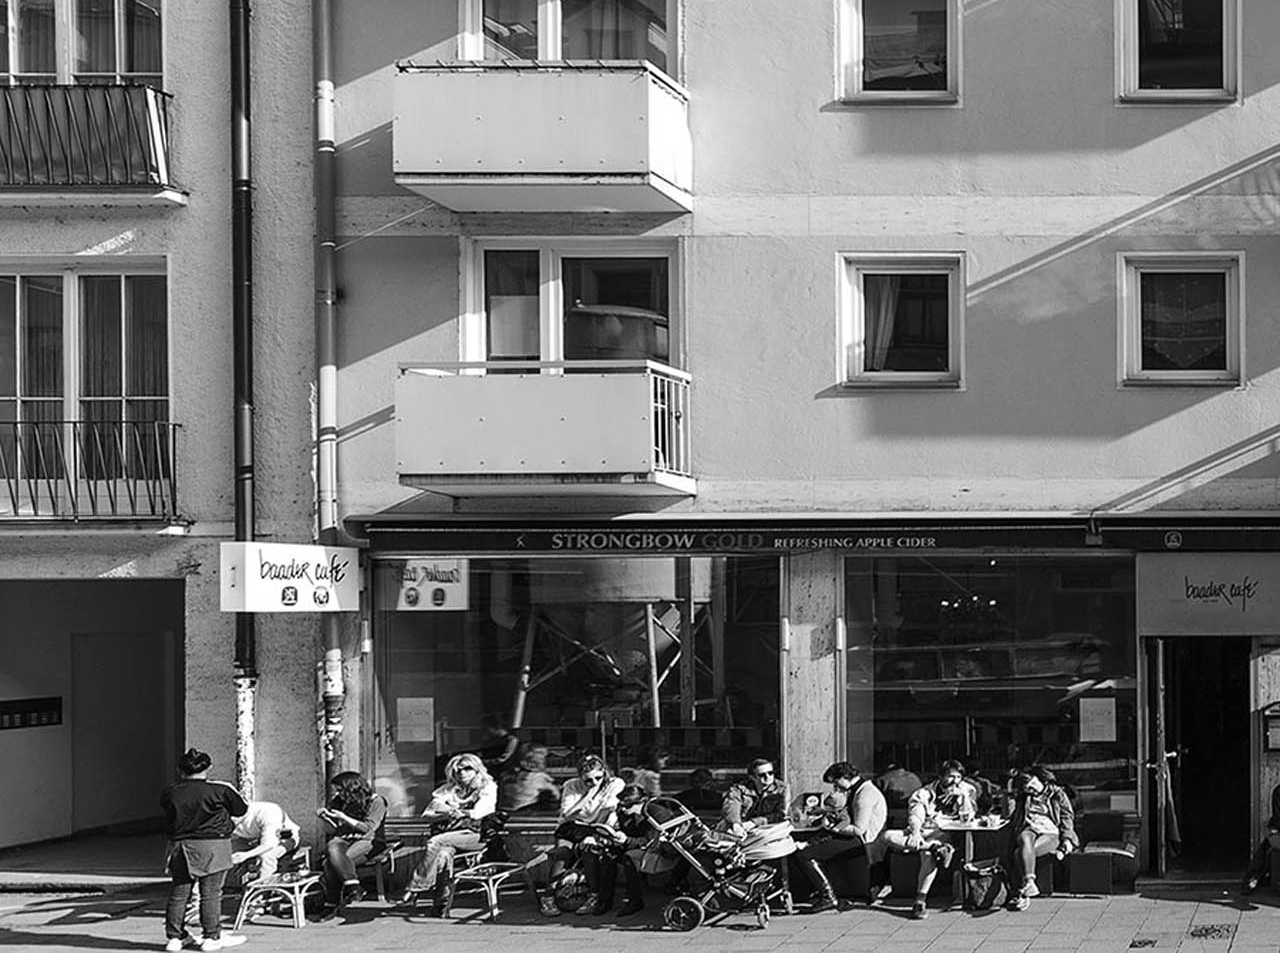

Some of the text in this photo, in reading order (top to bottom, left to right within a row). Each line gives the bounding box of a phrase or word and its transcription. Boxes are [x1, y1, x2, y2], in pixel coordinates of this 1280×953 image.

[552, 533, 936, 549] STRONGBOW GOLD REFRESHING APPLE CIDER
